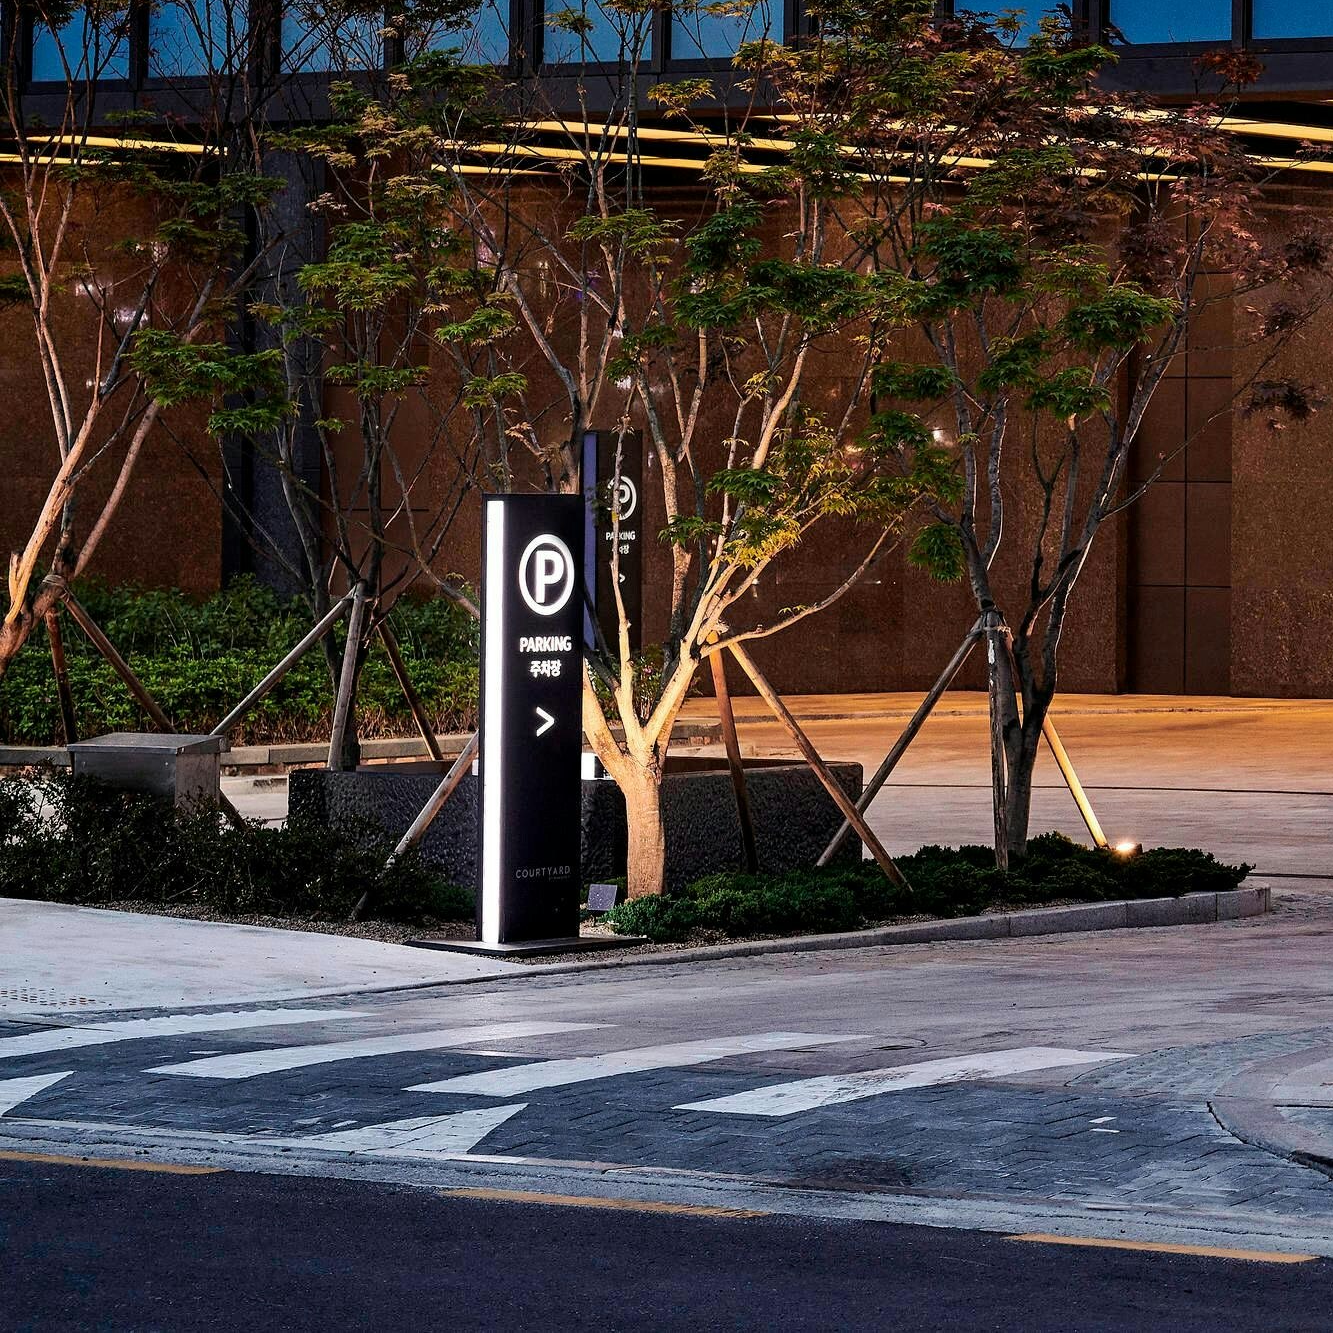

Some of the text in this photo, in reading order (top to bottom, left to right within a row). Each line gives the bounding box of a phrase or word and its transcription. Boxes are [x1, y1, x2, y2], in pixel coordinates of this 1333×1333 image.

[605, 530, 636, 541] PAKING
[535, 550, 564, 605] P
[519, 635, 572, 653] PARKING
[529, 658, 562, 679] 주차장
[515, 865, 571, 879] COURTYARD
